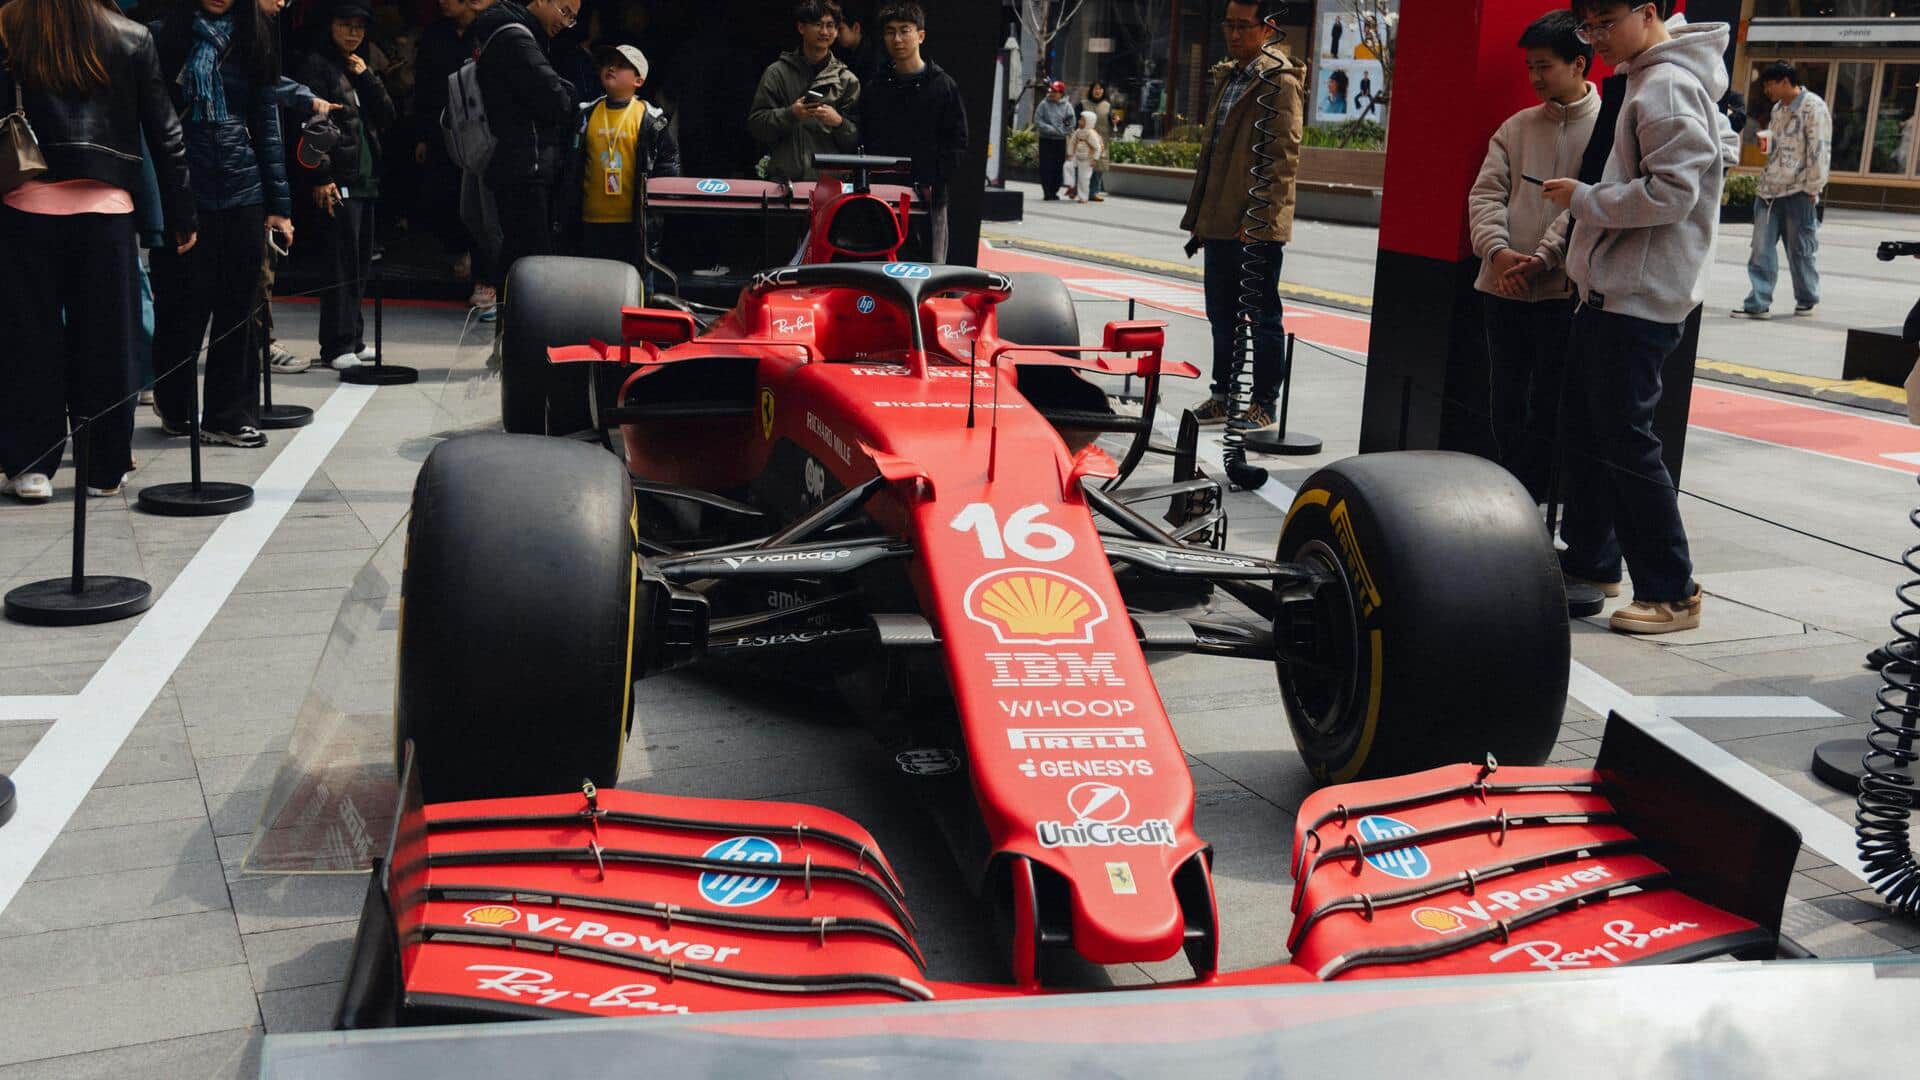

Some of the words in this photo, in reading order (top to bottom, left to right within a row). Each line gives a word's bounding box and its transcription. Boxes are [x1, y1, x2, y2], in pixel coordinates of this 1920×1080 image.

[888, 263, 927, 279] hp
[859, 296, 874, 313] hp
[773, 315, 813, 335] Ray-Ban
[938, 320, 977, 339] Ray-Ban
[872, 401, 1024, 409] Bitdefender
[806, 411, 833, 448] RICHARD
[833, 434, 852, 467] MILLE
[951, 502, 1075, 562] 16
[755, 549, 852, 563] vantage
[984, 652, 1126, 687] IBM
[998, 699, 1136, 717] WHOOP
[1007, 727, 1147, 750] PIRELLI
[1039, 759, 1154, 778] GENESYS
[1037, 820, 1176, 847] UniCredit
[1452, 864, 1613, 921] V-Power
[525, 912, 741, 963] V-Power
[1489, 918, 1699, 972] Ray-Ban
[465, 964, 694, 1016] Ray-Ban
